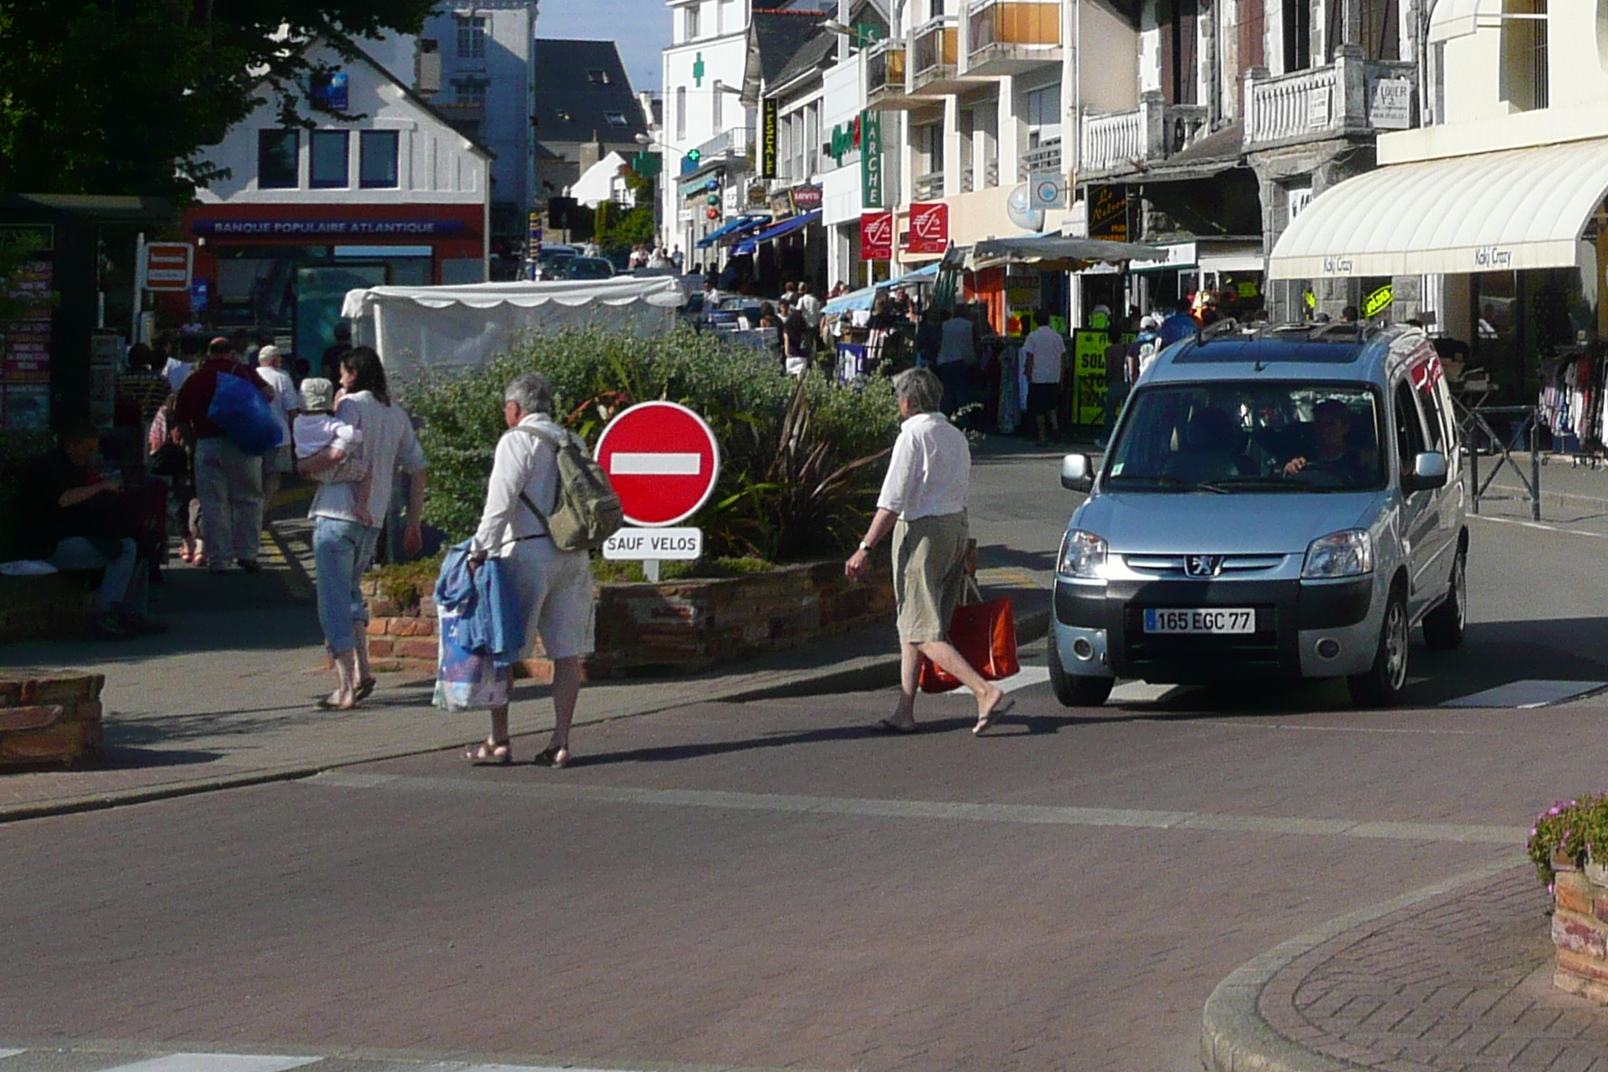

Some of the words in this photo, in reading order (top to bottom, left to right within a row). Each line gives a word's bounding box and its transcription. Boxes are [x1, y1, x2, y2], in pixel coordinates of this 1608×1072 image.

[214, 222, 270, 232] BANQUE
[274, 222, 346, 232] POPULAIRE
[349, 221, 434, 232] ATLANTIQUE
[607, 537, 635, 550] SAUF
[651, 537, 697, 551] VELOS
[1158, 612, 1188, 629] 165
[1192, 612, 1225, 630] EGC
[1229, 612, 1251, 629] 77
